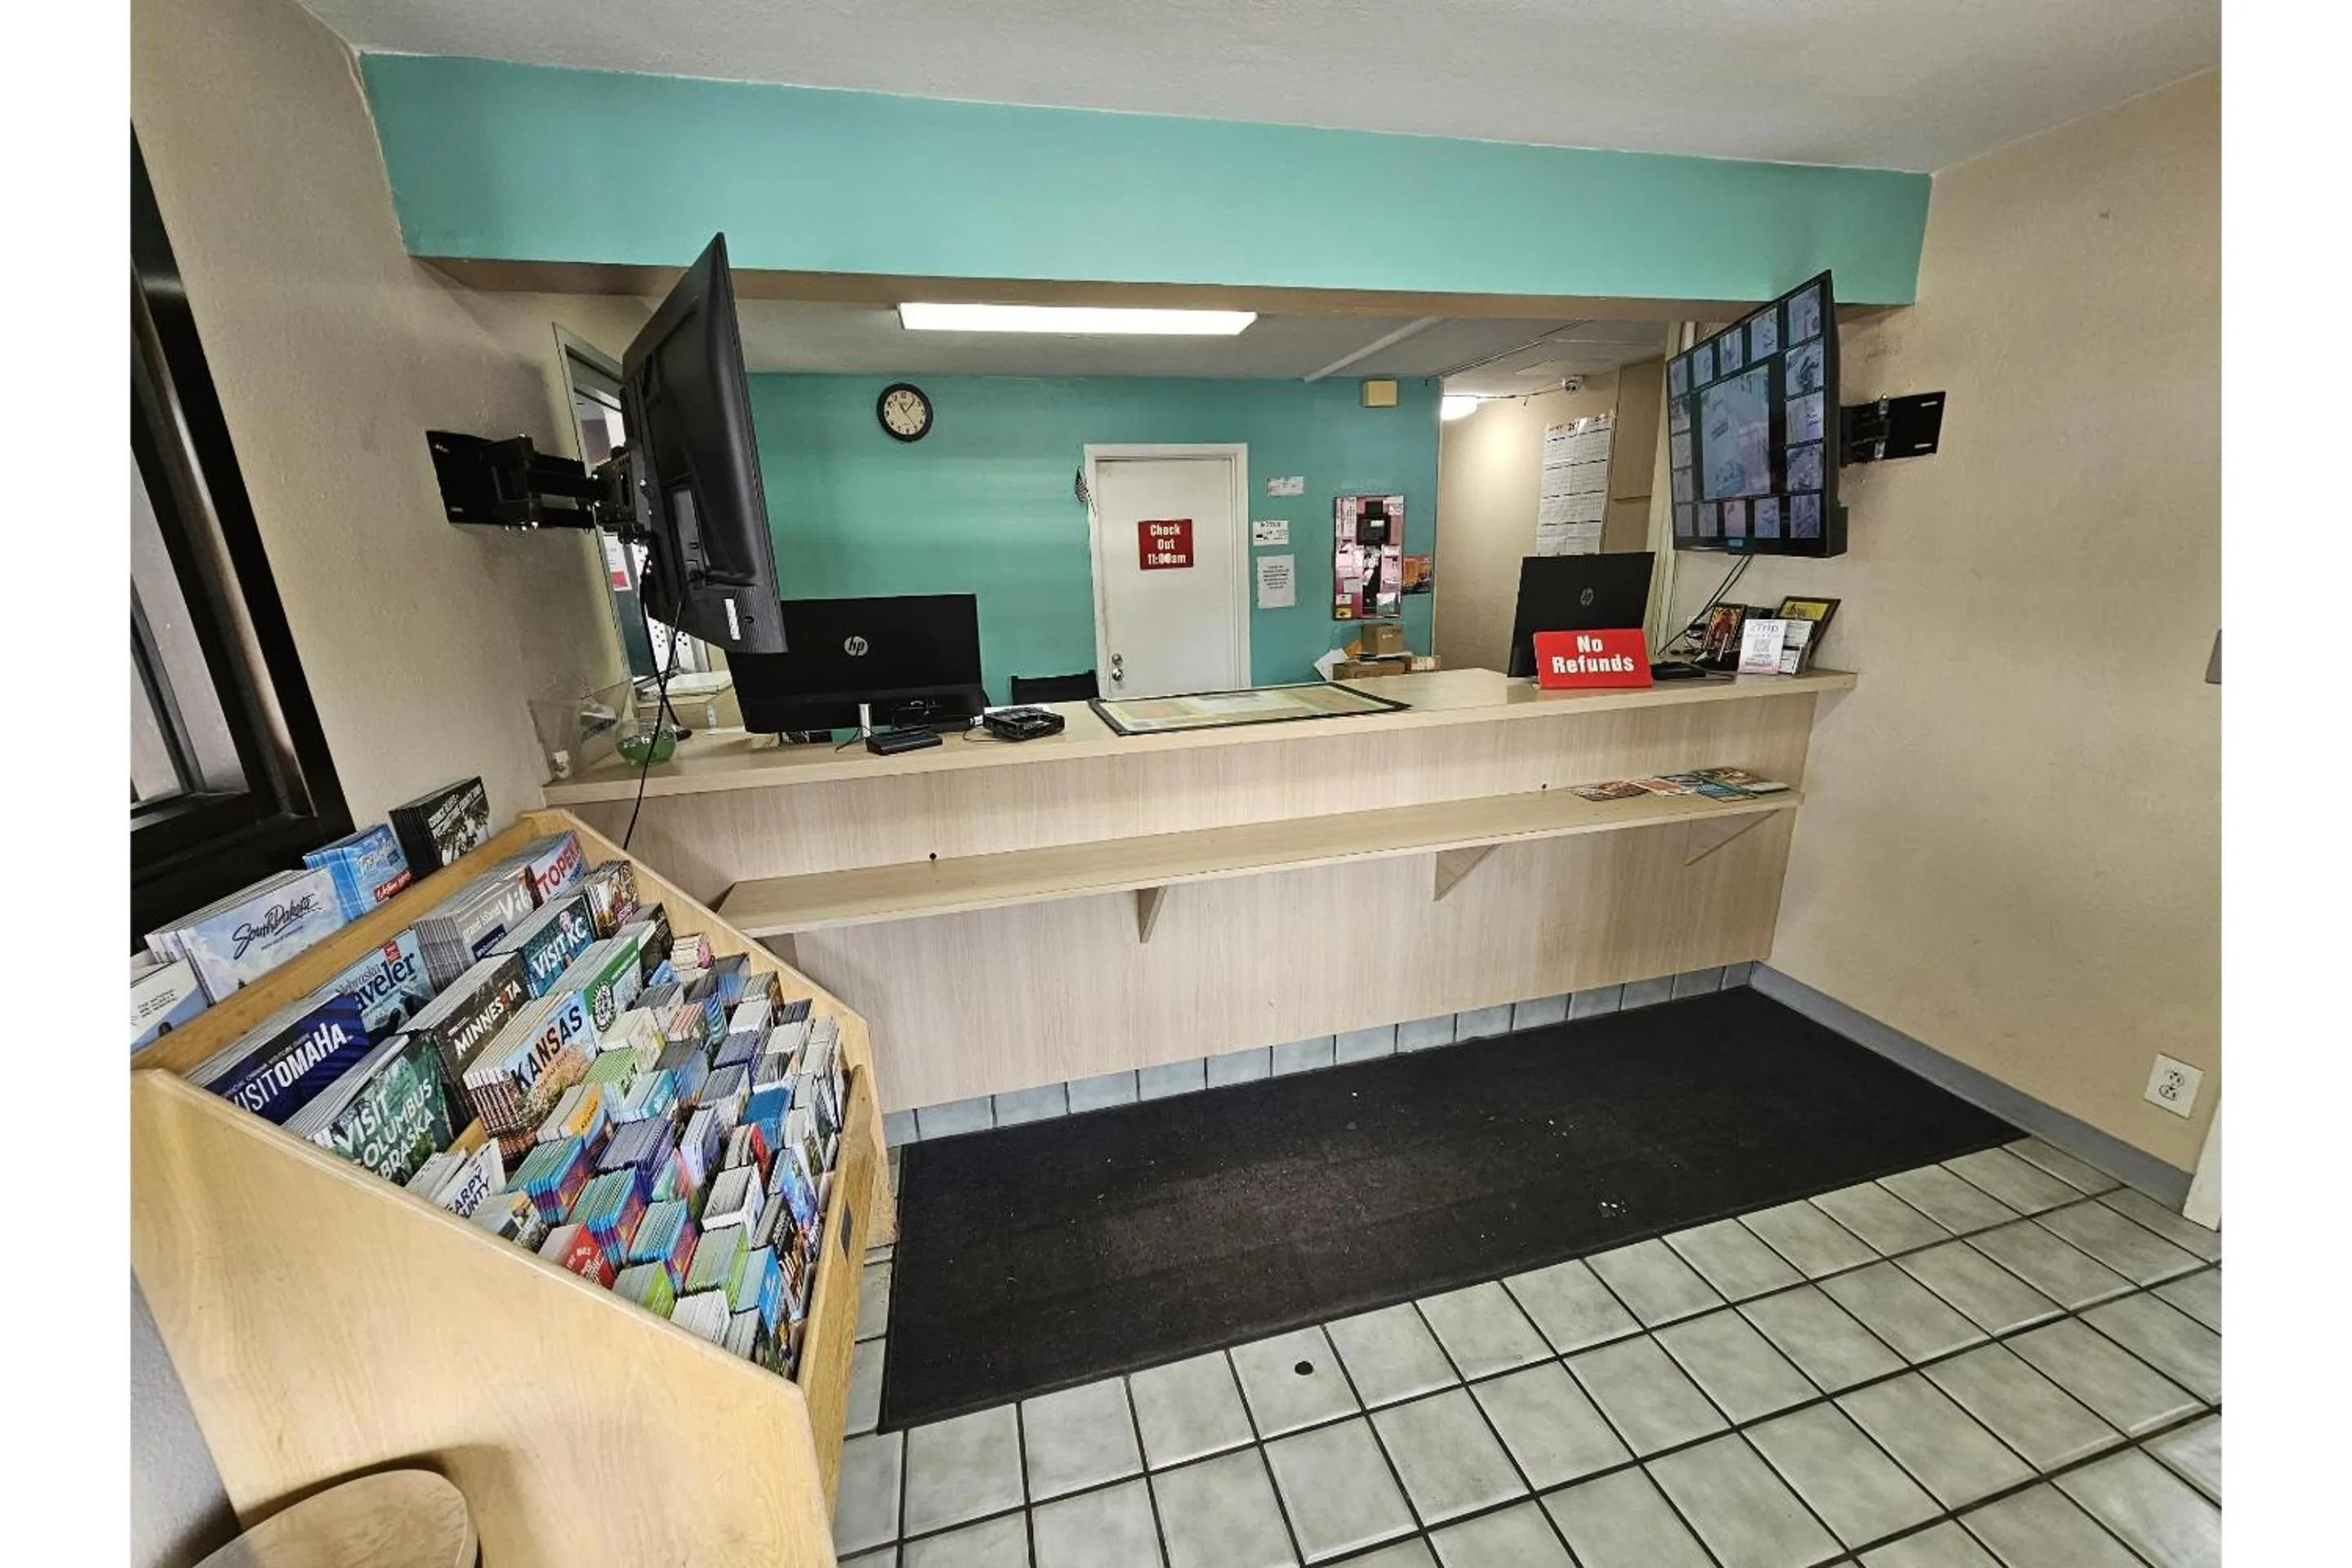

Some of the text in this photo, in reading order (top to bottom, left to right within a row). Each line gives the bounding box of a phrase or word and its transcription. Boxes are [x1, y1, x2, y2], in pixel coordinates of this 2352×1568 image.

[1151, 523, 1181, 537] Check
[1157, 538, 1175, 550] Out
[1147, 553, 1186, 565] 11:00am
[845, 636, 867, 656] hp
[1552, 654, 1634, 674] Refunds
[1577, 635, 1603, 653] No
[532, 933, 566, 978] VISIT
[566, 917, 586, 948] KC
[354, 952, 416, 1013] aveler
[453, 980, 522, 1059] MINNESTA
[510, 1005, 583, 1089] KANSAS
[332, 1089, 389, 1153] VISIT
[363, 1078, 432, 1168] OLUMBUS
[379, 1107, 435, 1180] BRASKA
[449, 1168, 482, 1215] ARPY
[462, 1176, 490, 1219] UNTY
